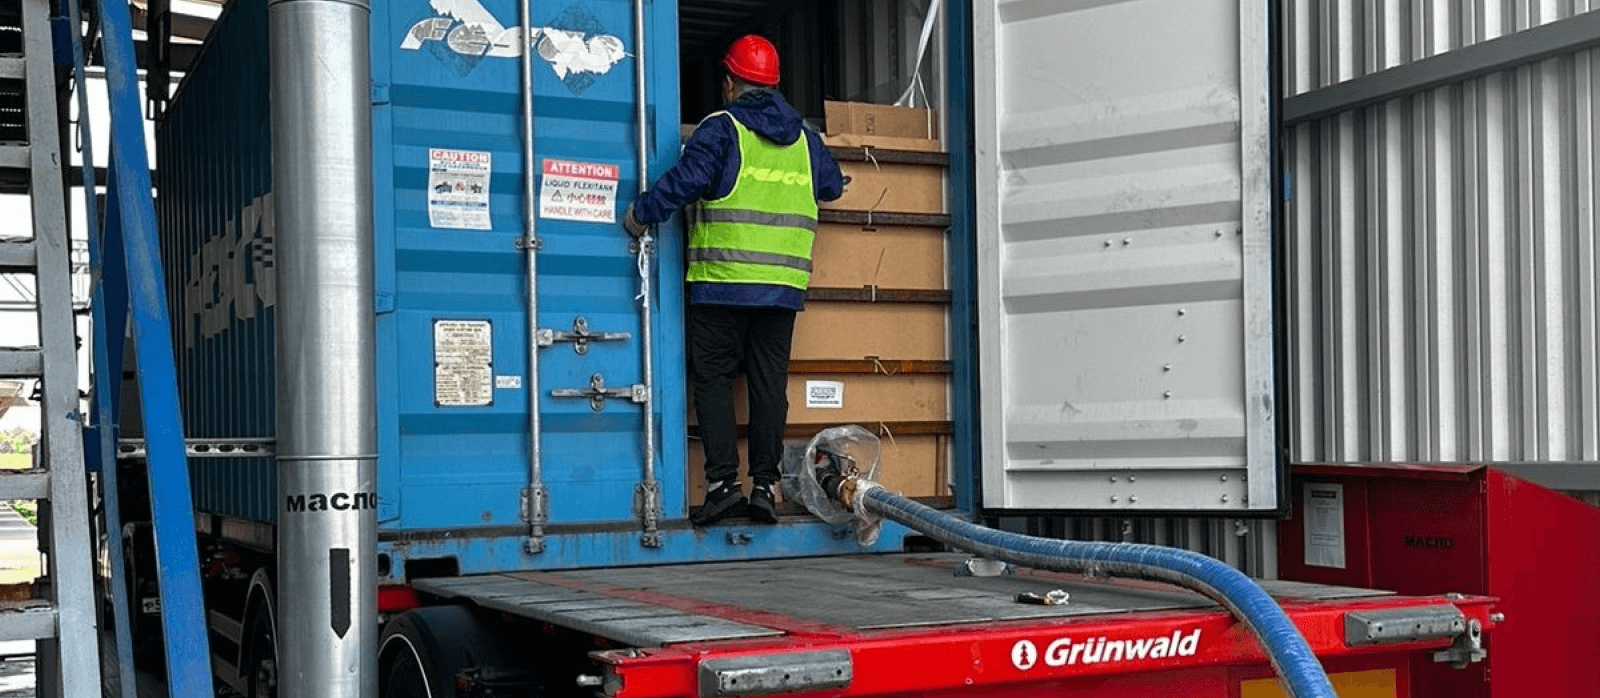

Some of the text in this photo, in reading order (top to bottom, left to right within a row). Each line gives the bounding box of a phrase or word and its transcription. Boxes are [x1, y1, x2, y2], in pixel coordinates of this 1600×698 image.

[433, 151, 488, 162] CAUTION
[550, 162, 613, 177] ATTENTION
[545, 180, 613, 191] LIQUID FLEXITANK
[545, 205, 613, 219] HANDLE WITH CARE
[1044, 629, 1202, 667] Grünwald
